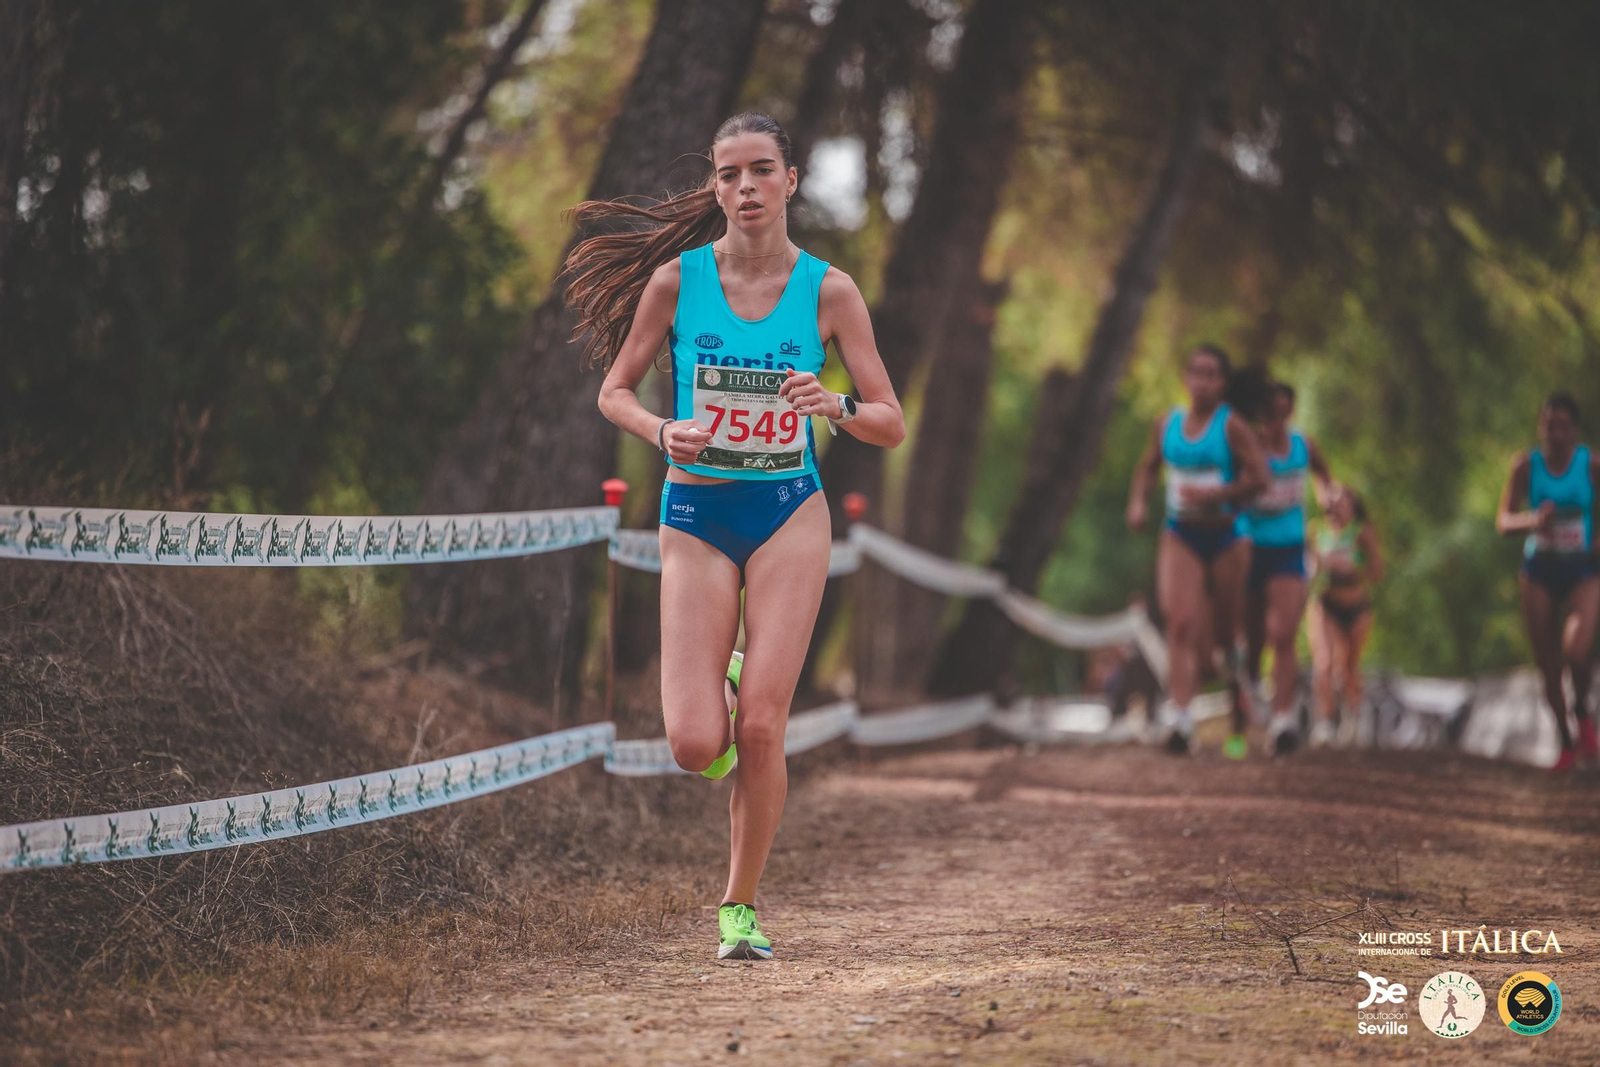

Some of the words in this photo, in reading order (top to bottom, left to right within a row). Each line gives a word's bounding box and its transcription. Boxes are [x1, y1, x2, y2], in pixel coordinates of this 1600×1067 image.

[696, 336, 723, 348] TROPS
[728, 372, 783, 387] ITÁLICA
[705, 404, 799, 445] 7549
[671, 503, 695, 514] nerja
